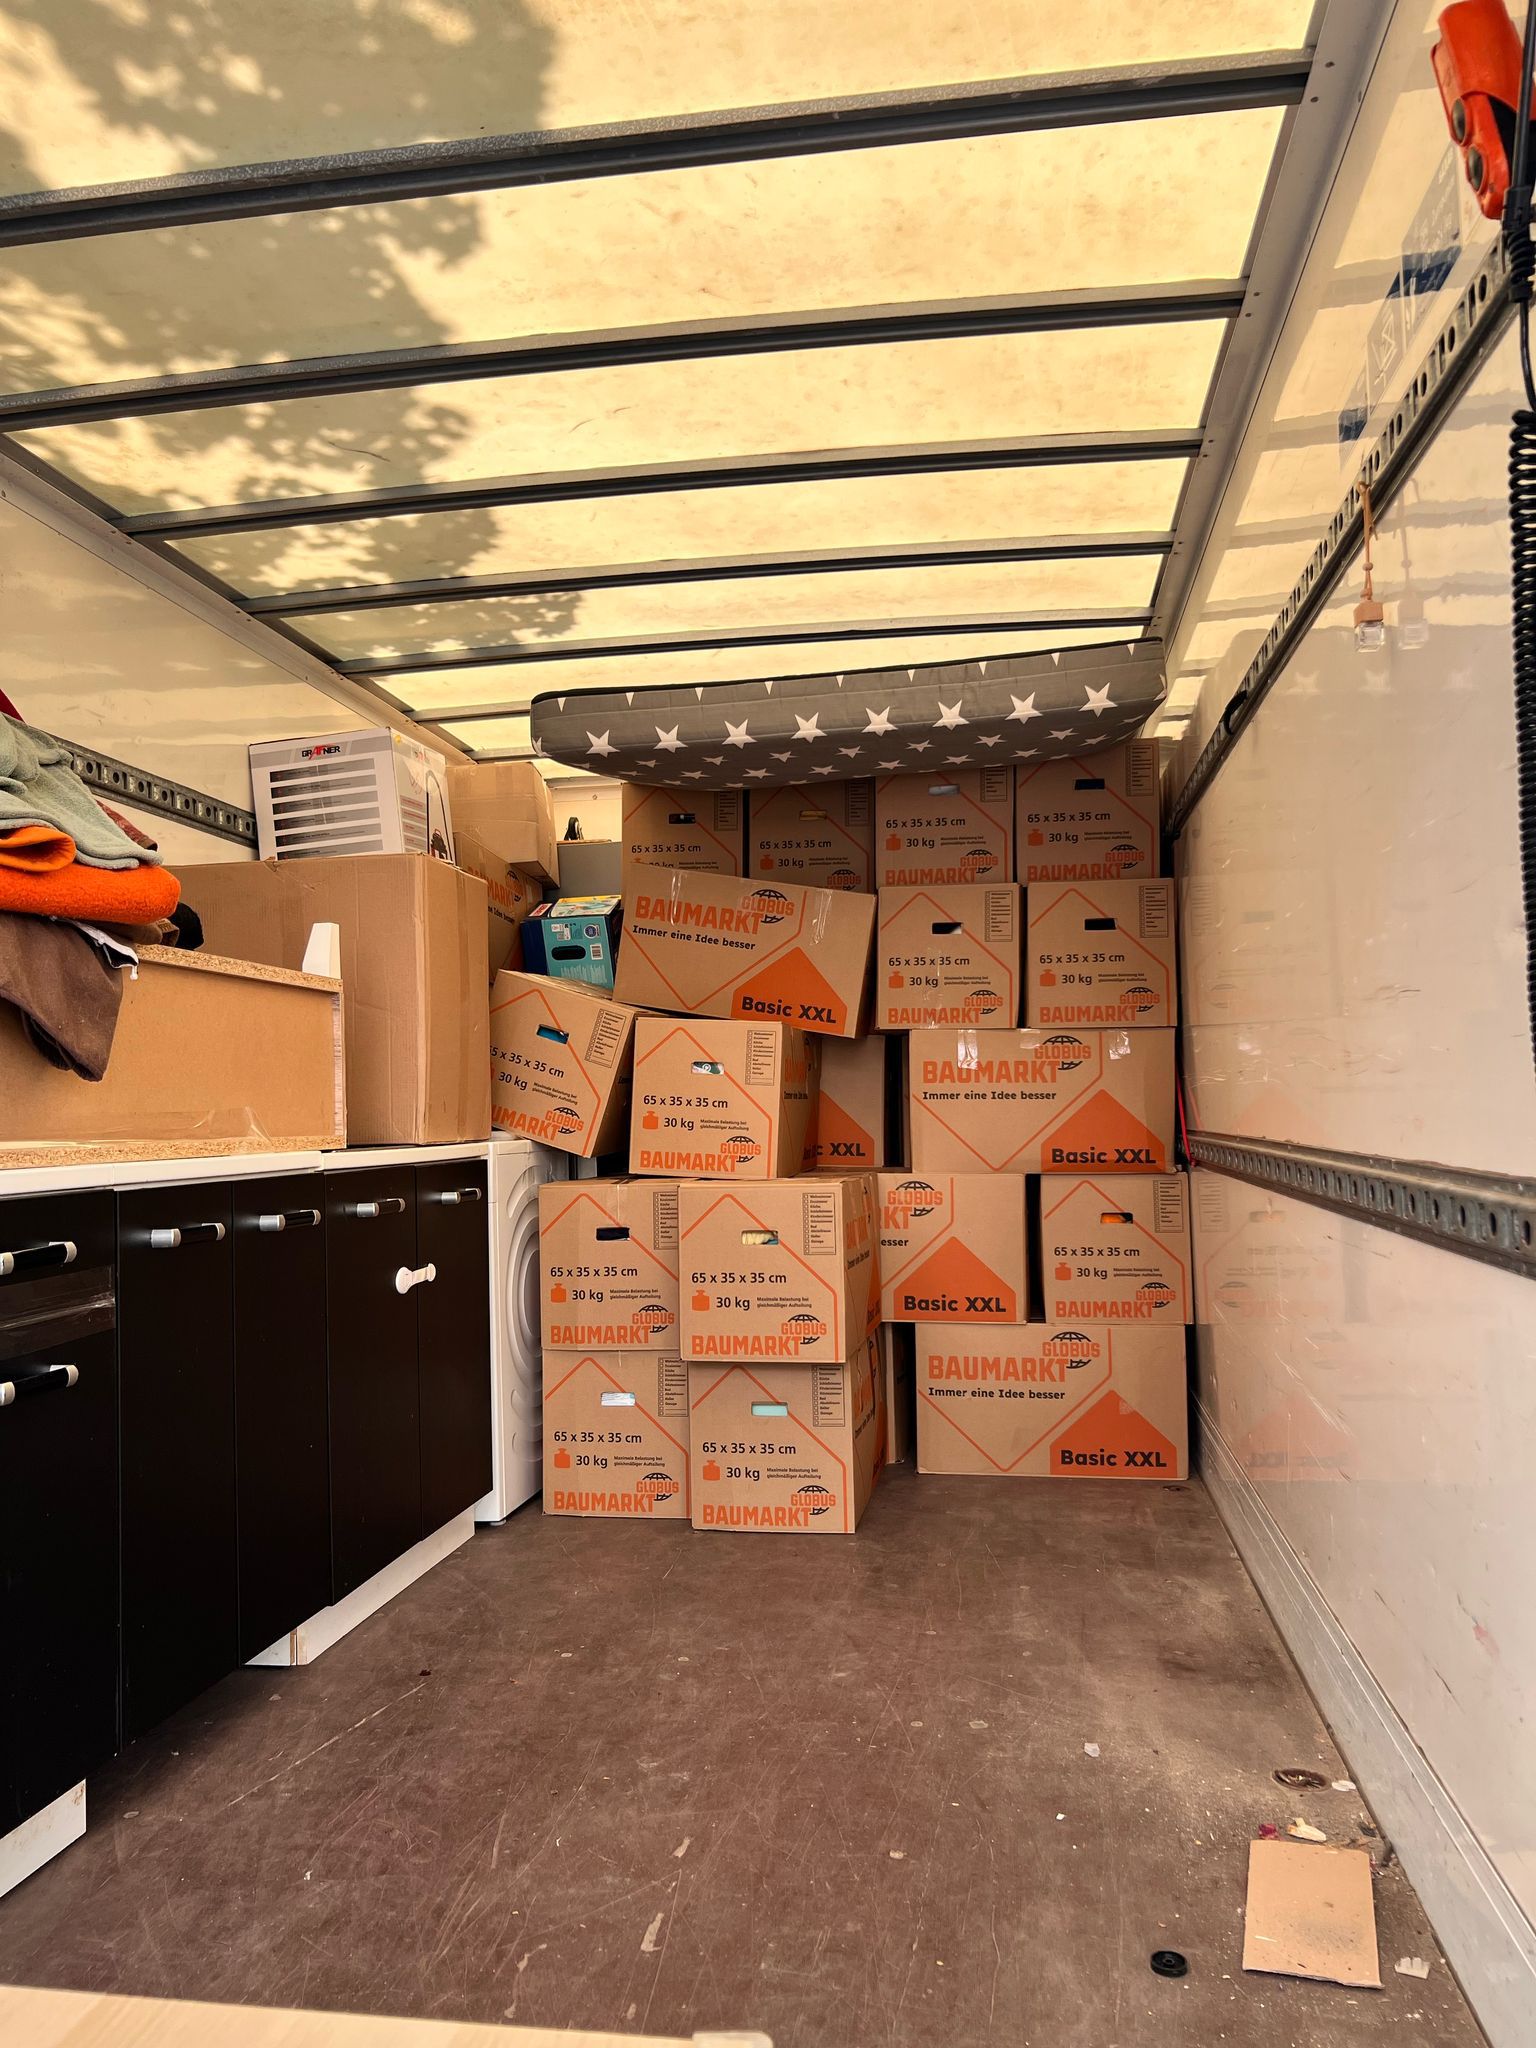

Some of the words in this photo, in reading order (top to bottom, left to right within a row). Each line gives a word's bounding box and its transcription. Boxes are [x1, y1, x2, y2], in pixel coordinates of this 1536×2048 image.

[885, 819, 898, 828] 65
[900, 820, 907, 828] x
[910, 818, 923, 827] 35
[925, 819, 932, 827] x
[934, 817, 947, 826] 35
[950, 818, 965, 826] cm
[1027, 813, 1040, 823] 65
[1052, 812, 1066, 822] 35
[1078, 811, 1092, 821] 35
[1094, 812, 1110, 820] cm
[906, 838, 919, 847] 30
[921, 837, 934, 849] kg
[1048, 832, 1062, 842] 30
[1064, 831, 1078, 844] kg
[778, 858, 789, 867] 30
[791, 857, 803, 868] kg
[960, 856, 998, 867] GLOBUS
[1105, 851, 1144, 862] GLOBUS
[886, 867, 978, 886] BAUMARKT
[1028, 862, 1122, 881] BAUMARKT
[826, 875, 862, 888] GLOBUS
[742, 894, 794, 917] GLOBUS
[635, 896, 762, 935] BAUMARKT
[632, 924, 668, 937] Immer
[670, 929, 692, 941] eine
[694, 933, 719, 944] Idee
[722, 937, 755, 950] besser
[888, 957, 901, 966] 65
[904, 958, 910, 966] x
[913, 956, 926, 966] 35
[939, 956, 951, 965] 35
[1039, 954, 1052, 964] 65
[1065, 953, 1079, 963] 35
[1091, 952, 1105, 962] 35
[1108, 954, 1125, 962] cm
[909, 976, 922, 986] 30
[925, 975, 938, 988] kg
[1061, 974, 1075, 984] 30
[1078, 973, 1092, 985] kg
[964, 997, 1004, 1008] GLOBUS
[1120, 993, 1160, 1005] GLOBUS
[741, 996, 792, 1016] Basic
[798, 1004, 836, 1023] XXL
[888, 1006, 981, 1024] BAUMARKT
[1040, 1004, 1137, 1023] BAUMARKT
[1034, 1044, 1091, 1060] GLOBUS
[490, 1044, 498, 1056] 5
[500, 1051, 508, 1060] x
[508, 1052, 522, 1064] 35
[524, 1059, 531, 1068] x
[532, 1060, 547, 1072] 35
[548, 1067, 564, 1078] cm
[922, 1060, 1060, 1084] BAUMARKT
[496, 1071, 512, 1083] 30
[513, 1075, 527, 1090] kg
[643, 1094, 656, 1105] 65
[659, 1097, 666, 1105] x
[669, 1095, 682, 1106] 35
[685, 1098, 692, 1106] x
[695, 1097, 708, 1107] 35
[711, 1100, 728, 1108] cm
[922, 1091, 960, 1100] Immer
[963, 1090, 987, 1099] eine
[990, 1090, 1017, 1099] Idee
[1020, 1090, 1056, 1099] besser
[492, 1104, 561, 1141] UMARKT
[545, 1110, 584, 1131] GLOBUS
[663, 1117, 677, 1127] 30
[680, 1117, 694, 1131] kg
[720, 1142, 761, 1156] GLOBUS
[829, 1142, 865, 1156] XXL
[1052, 1146, 1107, 1164] Basic
[1114, 1148, 1156, 1164] XXL
[640, 1150, 738, 1172] BAUMARKT
[887, 1190, 943, 1206] GLOBUS
[881, 1238, 909, 1247] esser
[1054, 1246, 1067, 1256] 65
[1070, 1248, 1077, 1256] x
[1080, 1246, 1094, 1256] 35
[1096, 1248, 1104, 1256] x
[1106, 1246, 1120, 1256] 35
[1123, 1248, 1140, 1256] cm
[550, 1266, 563, 1277] 65
[566, 1268, 573, 1277] x
[576, 1266, 590, 1277] 35
[593, 1268, 600, 1276] x
[603, 1266, 617, 1276] 35
[620, 1268, 637, 1276] cm
[691, 1272, 706, 1283] 65
[709, 1274, 717, 1283] x
[720, 1272, 735, 1283] 35
[738, 1274, 746, 1283] x
[750, 1272, 764, 1283] 35
[768, 1274, 786, 1283] cm
[1076, 1267, 1090, 1277] 30
[1093, 1267, 1107, 1280] kg
[572, 1289, 585, 1300] 30
[589, 1288, 603, 1302] kg
[1136, 1290, 1176, 1301] GLOBUS
[716, 1296, 731, 1308] 30
[734, 1296, 750, 1311] kg
[903, 1294, 958, 1311] Basic
[965, 1296, 1006, 1312] XXL
[1056, 1300, 1153, 1318] BAUMARKT
[632, 1312, 674, 1325] GLOBUS
[551, 1326, 650, 1345] BAUMARKT
[781, 1322, 826, 1336] GLOBUS
[692, 1336, 802, 1356] BAUMARKT
[1042, 1342, 1100, 1358] GLOBUS
[928, 1355, 1070, 1382] BAUMARKT
[928, 1387, 967, 1397] Immer
[970, 1387, 994, 1398] eine
[998, 1388, 1024, 1398] Idee
[1028, 1389, 1065, 1399] besser
[553, 1430, 567, 1441] 65
[570, 1433, 577, 1442] x
[580, 1431, 594, 1442] 35
[597, 1434, 604, 1442] x
[607, 1432, 621, 1443] 35
[625, 1434, 641, 1443] cm
[702, 1441, 716, 1452] 65
[720, 1444, 727, 1453] x
[730, 1442, 745, 1453] 35
[748, 1445, 756, 1453] x
[759, 1443, 774, 1454] 35
[778, 1445, 796, 1454] cm
[575, 1454, 590, 1465] 30
[593, 1454, 607, 1469] kg
[1060, 1448, 1116, 1466] Basic
[1124, 1451, 1167, 1467] XXL
[726, 1466, 741, 1478] 30
[744, 1466, 760, 1481] kg
[636, 1480, 678, 1494] GLOBUS
[554, 1491, 656, 1513] BAUMARKT
[791, 1494, 836, 1507] GLOBUS
[703, 1504, 811, 1527] BAUMARKT
